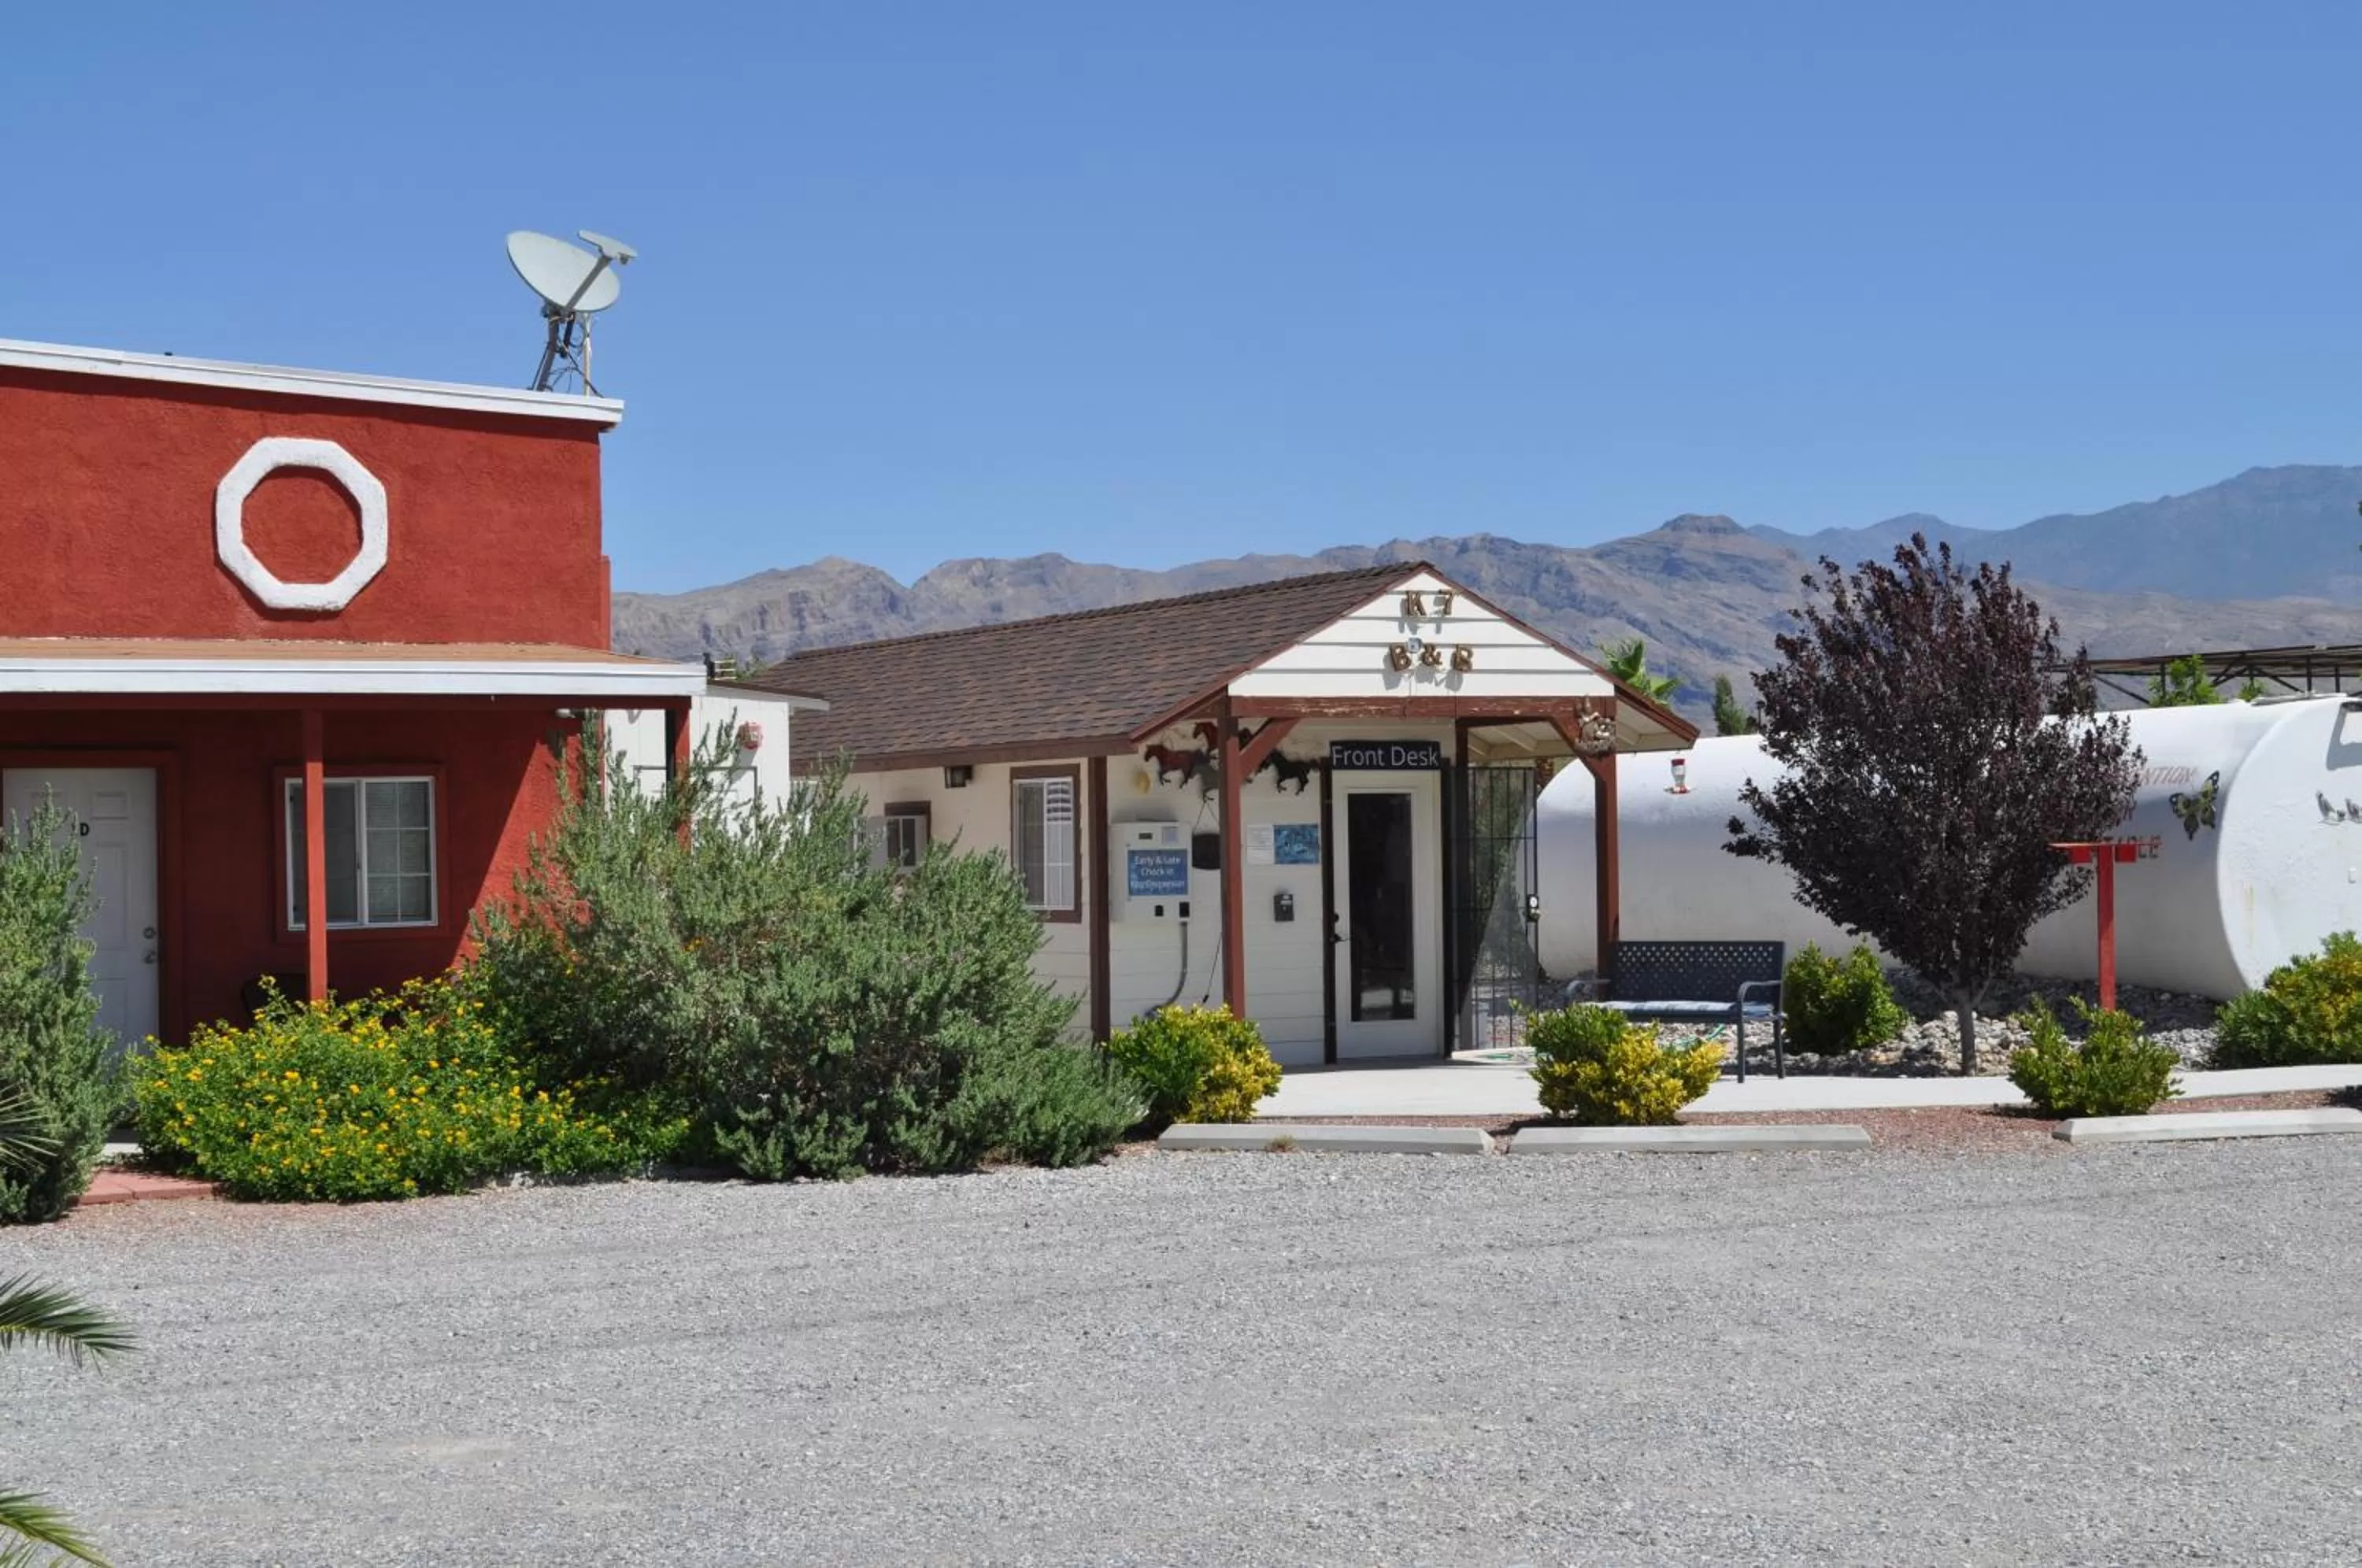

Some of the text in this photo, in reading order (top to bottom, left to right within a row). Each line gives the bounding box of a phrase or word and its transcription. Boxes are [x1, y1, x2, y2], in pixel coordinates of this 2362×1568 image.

[1331, 745, 1439, 767] Front Desk
[1134, 856, 1153, 867] Early
[1140, 867, 1164, 876] Check
